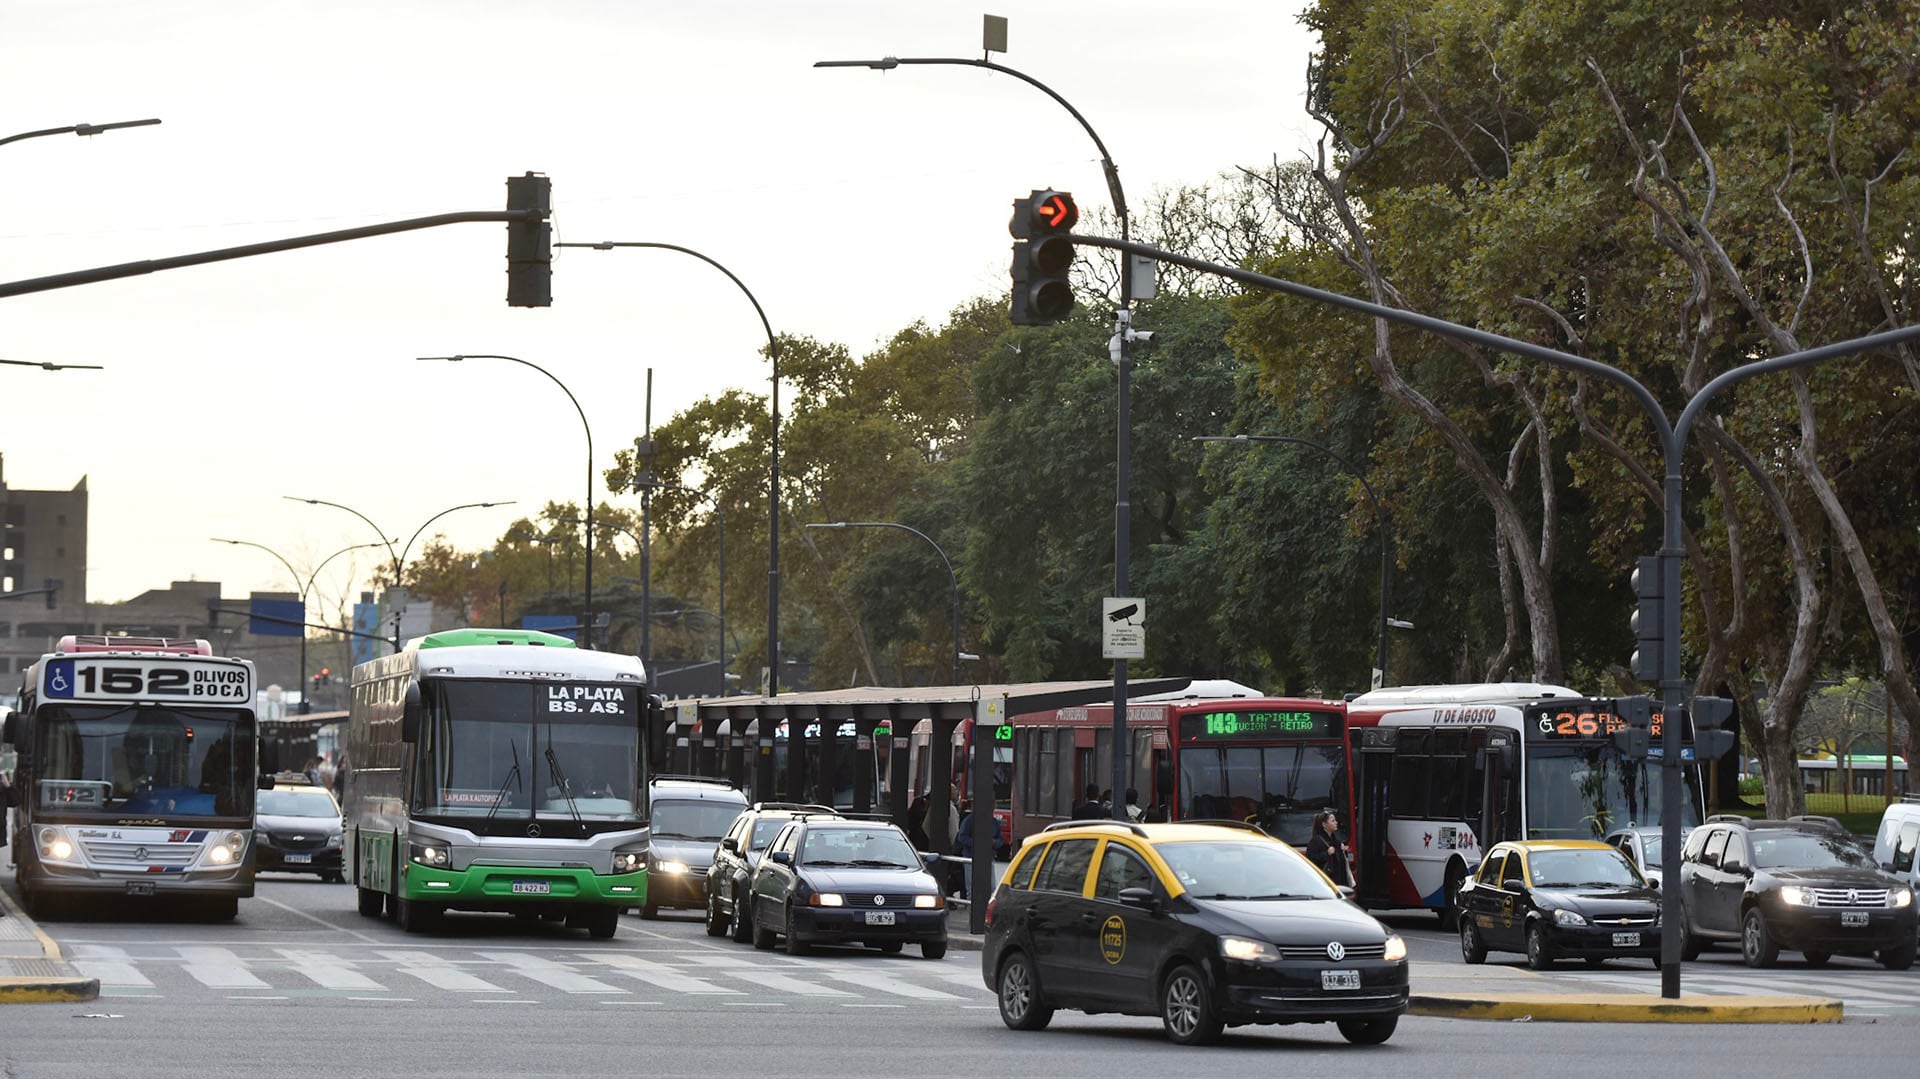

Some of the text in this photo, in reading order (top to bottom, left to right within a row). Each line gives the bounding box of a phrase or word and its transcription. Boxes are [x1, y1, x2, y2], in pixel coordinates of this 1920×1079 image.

[78, 666, 245, 696] 152 OLIVOS
[193, 684, 245, 697] BOCA
[549, 686, 625, 701] LA PLATA
[549, 701, 625, 714] BS. AS.
[1205, 712, 1238, 734] 143
[1433, 708, 1497, 724] 17 DE AGOSTO
[1555, 712, 1599, 735] 26
[1458, 831, 1474, 850] 234
[525, 885, 538, 893] 422
[1342, 975, 1358, 986] 319
